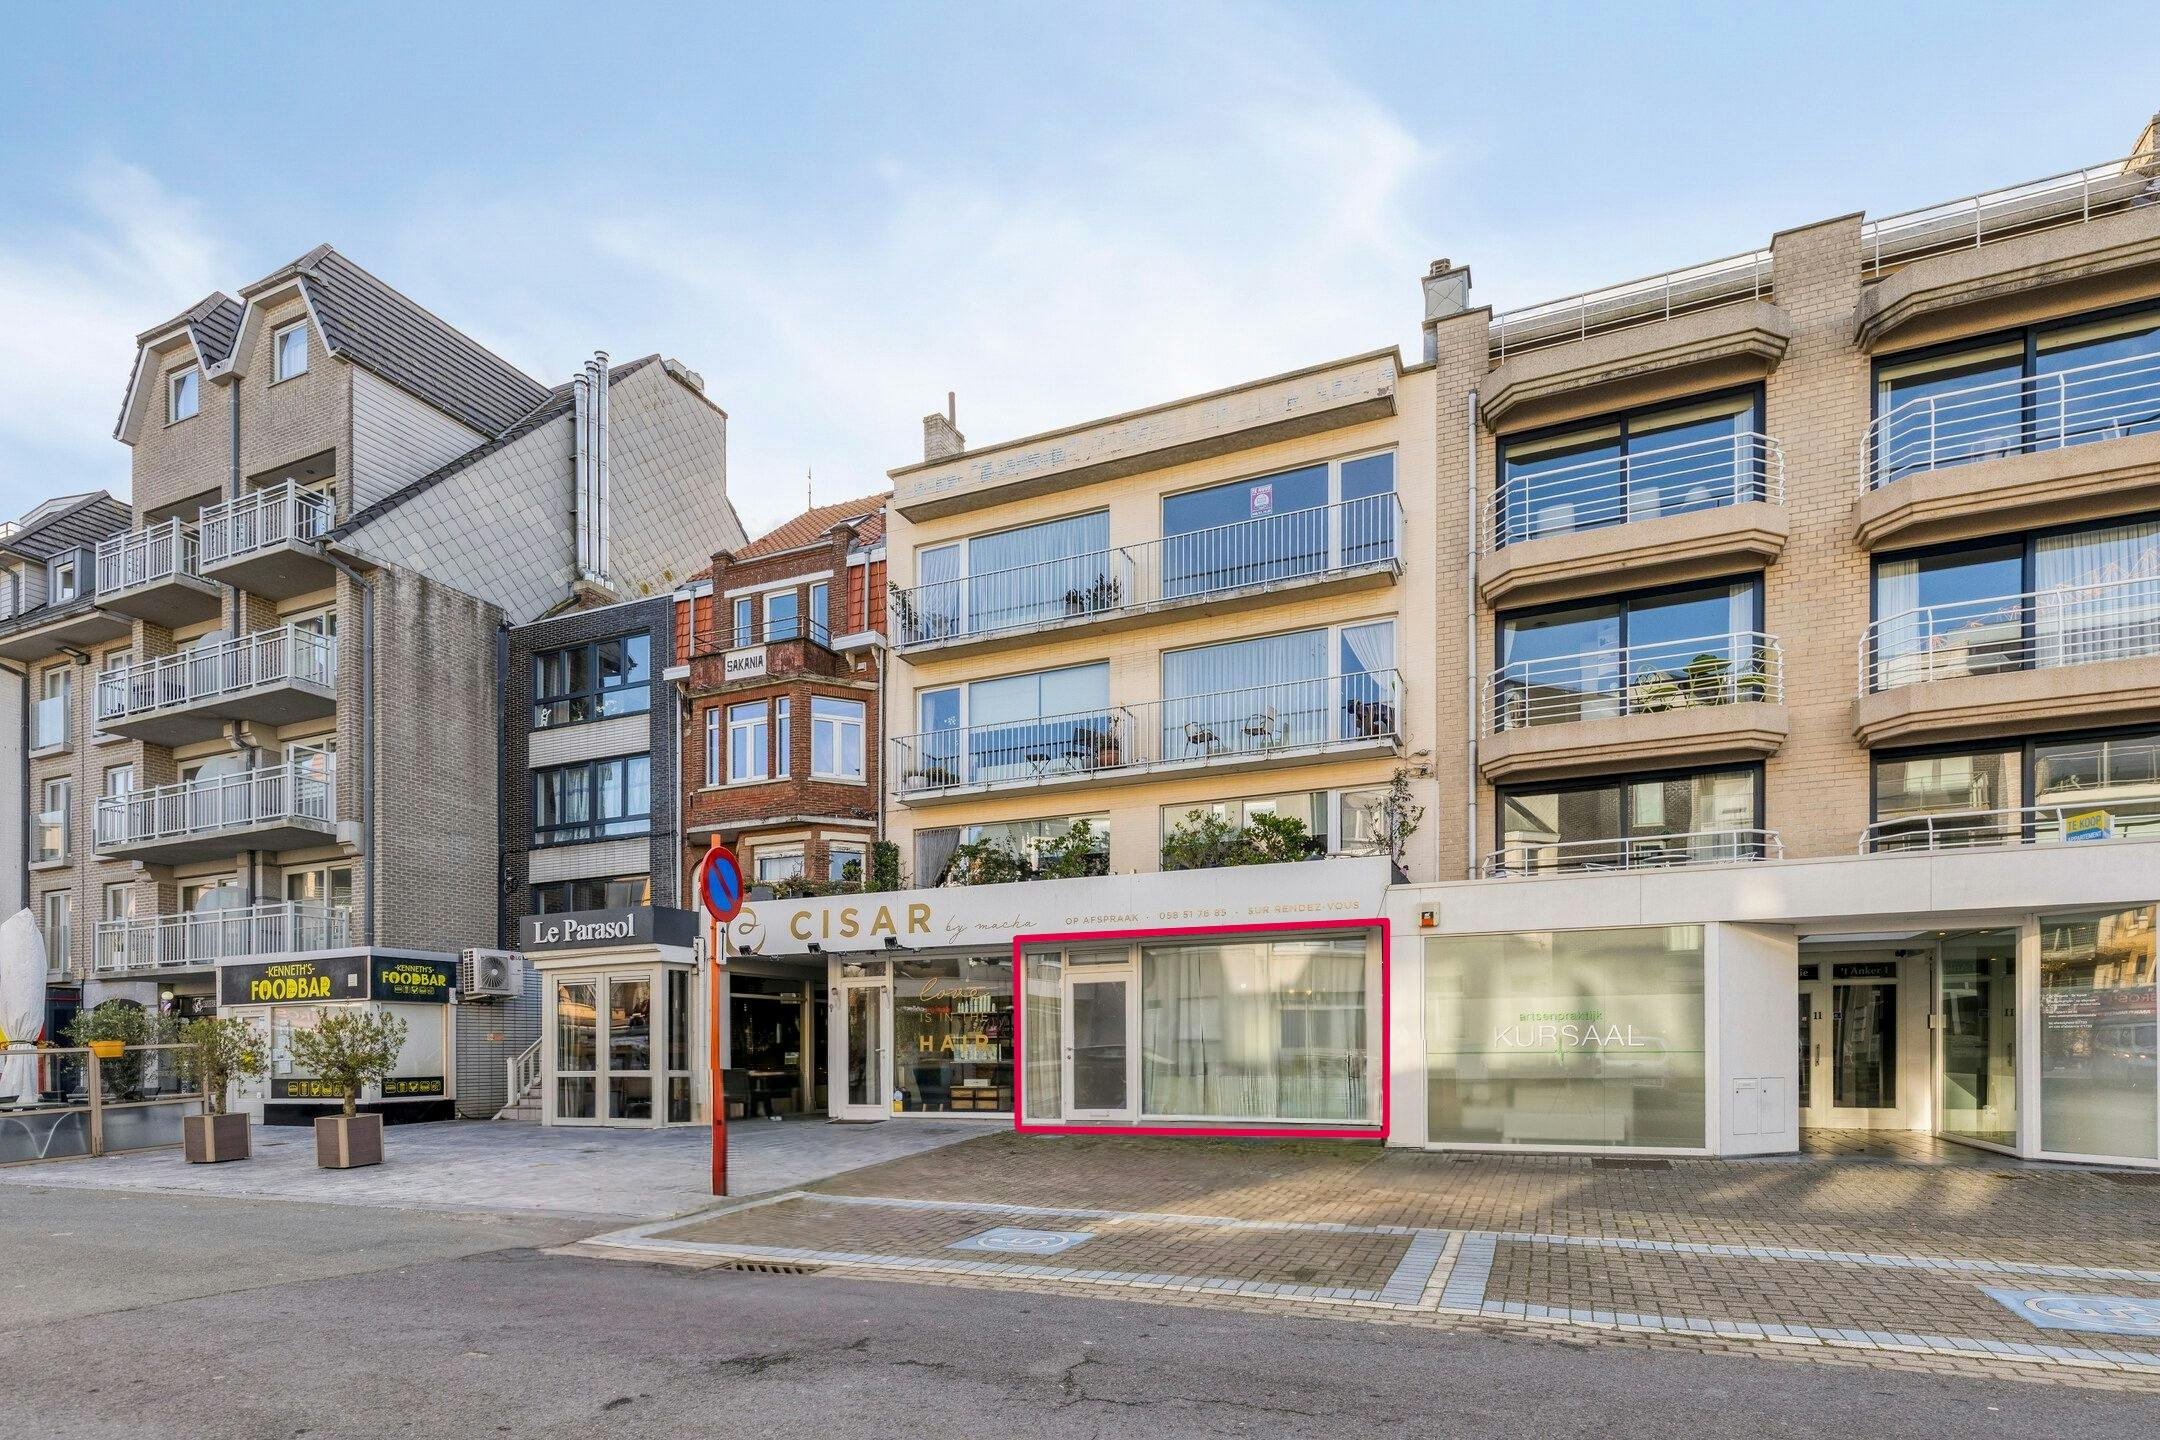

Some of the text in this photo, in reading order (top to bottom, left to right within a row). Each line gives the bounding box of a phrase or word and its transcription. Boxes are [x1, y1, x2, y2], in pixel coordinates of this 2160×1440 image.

[727, 655, 763, 672] SAKANIA
[2067, 821, 2077, 830] TE
[2079, 815, 2101, 829] KOOP
[790, 903, 932, 940] CISAR
[1065, 916, 1079, 926] OP
[1083, 913, 1139, 924] AFSPRAAK
[1247, 905, 1270, 915] SUR
[1275, 901, 1361, 913] RENDEZ-VOUS
[533, 914, 637, 944] Le Parasol
[1850, 966, 1881, 975] Anker
[382, 972, 447, 987] FOODBAR
[251, 976, 331, 1001] FOODBAR
[1813, 1011, 1822, 1020] 11
[919, 1035, 989, 1052] HAIR
[1494, 1024, 1645, 1047] KURSAAL
